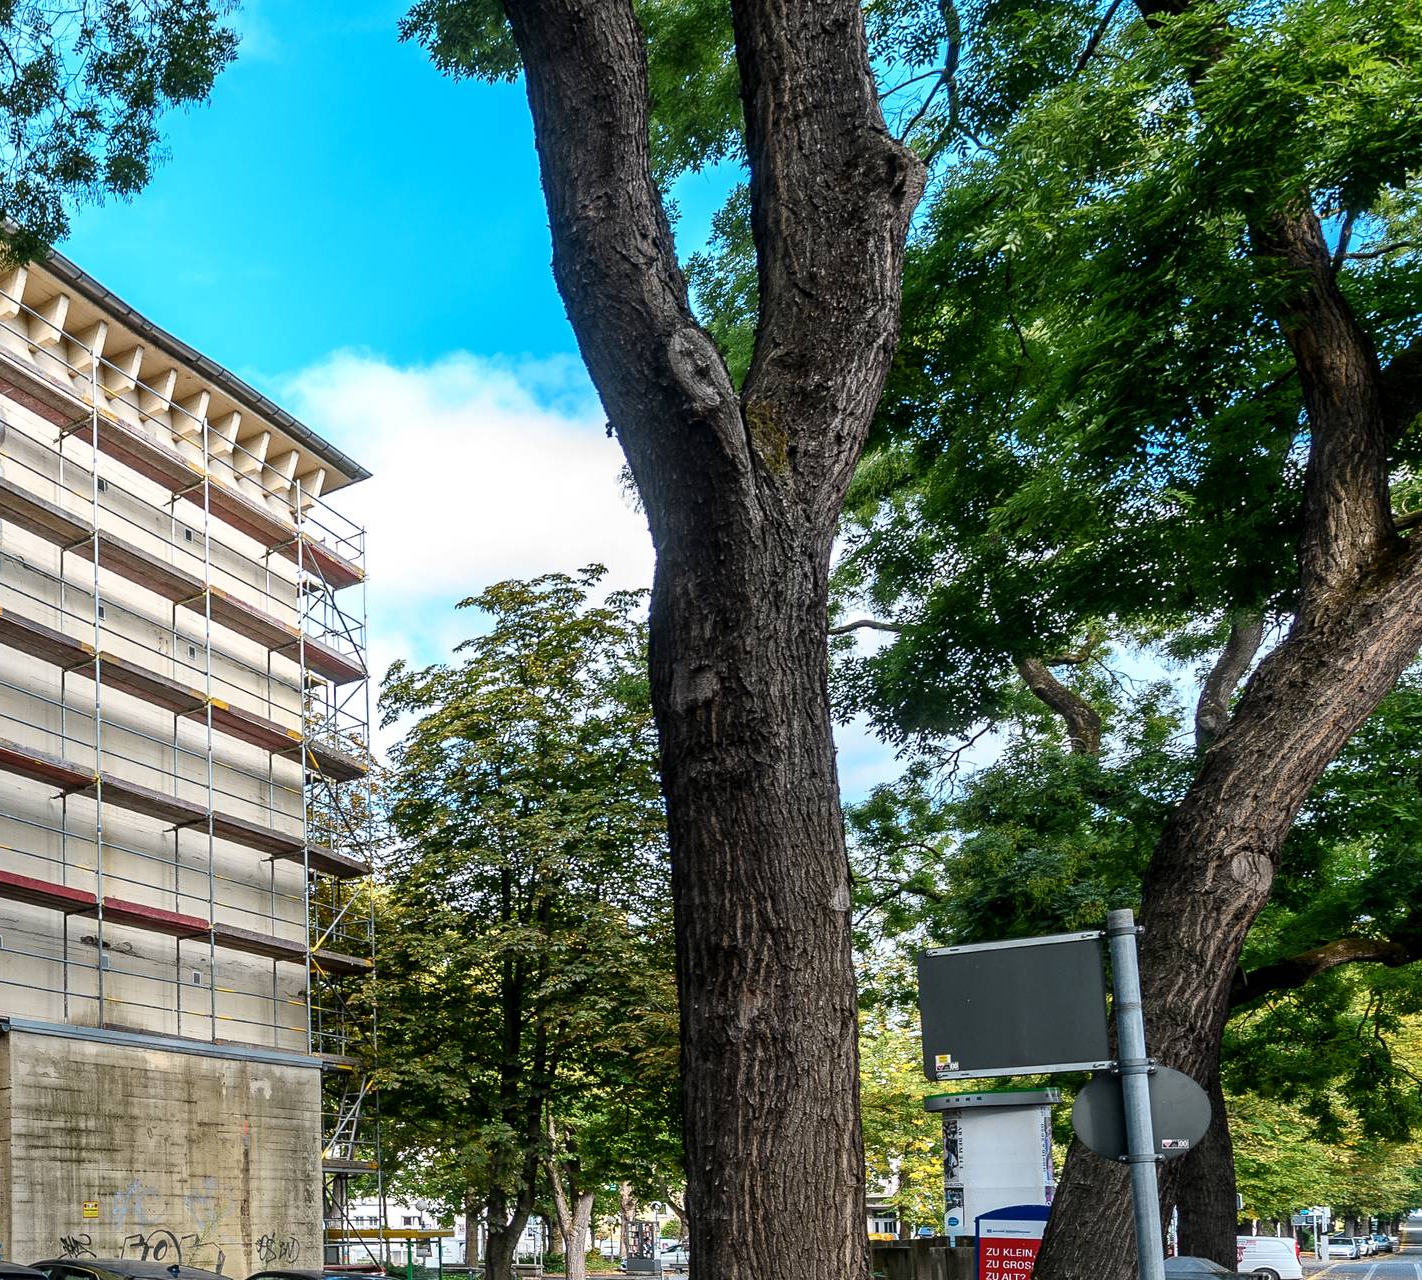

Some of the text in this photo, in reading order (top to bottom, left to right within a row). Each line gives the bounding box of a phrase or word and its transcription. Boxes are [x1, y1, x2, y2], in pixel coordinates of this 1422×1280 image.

[986, 1247, 1036, 1258] ZU KLEIN,
[986, 1259, 1000, 1269] ZU
[986, 1271, 1000, 1280] ZU
